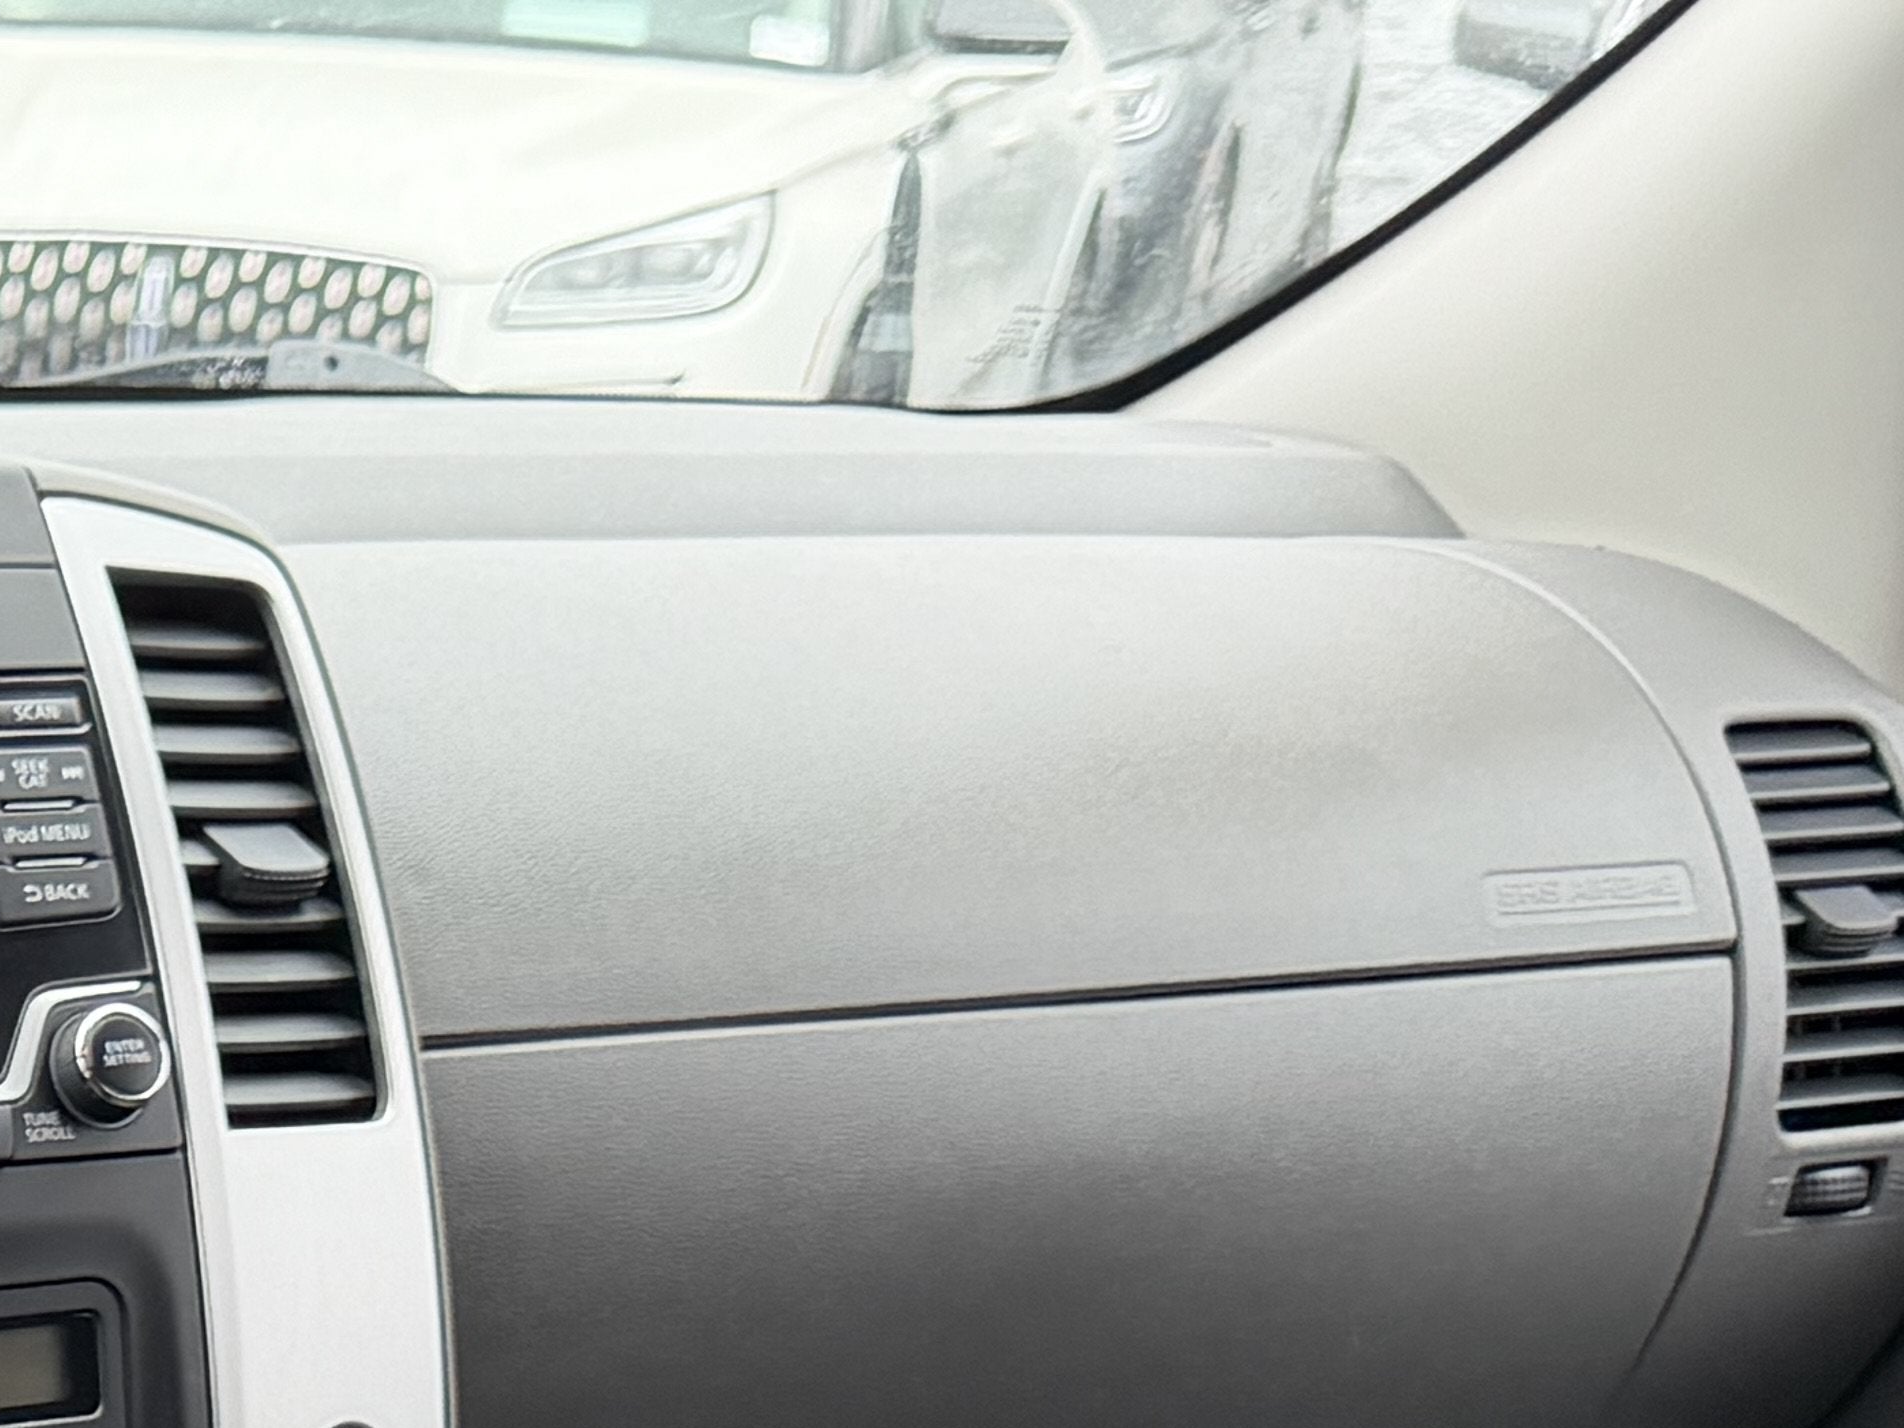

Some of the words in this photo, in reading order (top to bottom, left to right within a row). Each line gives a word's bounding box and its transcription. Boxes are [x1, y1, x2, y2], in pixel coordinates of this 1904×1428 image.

[40, 822, 91, 842] MENU
[44, 882, 91, 902] BACK
[24, 1125, 76, 1143] SCROLL
